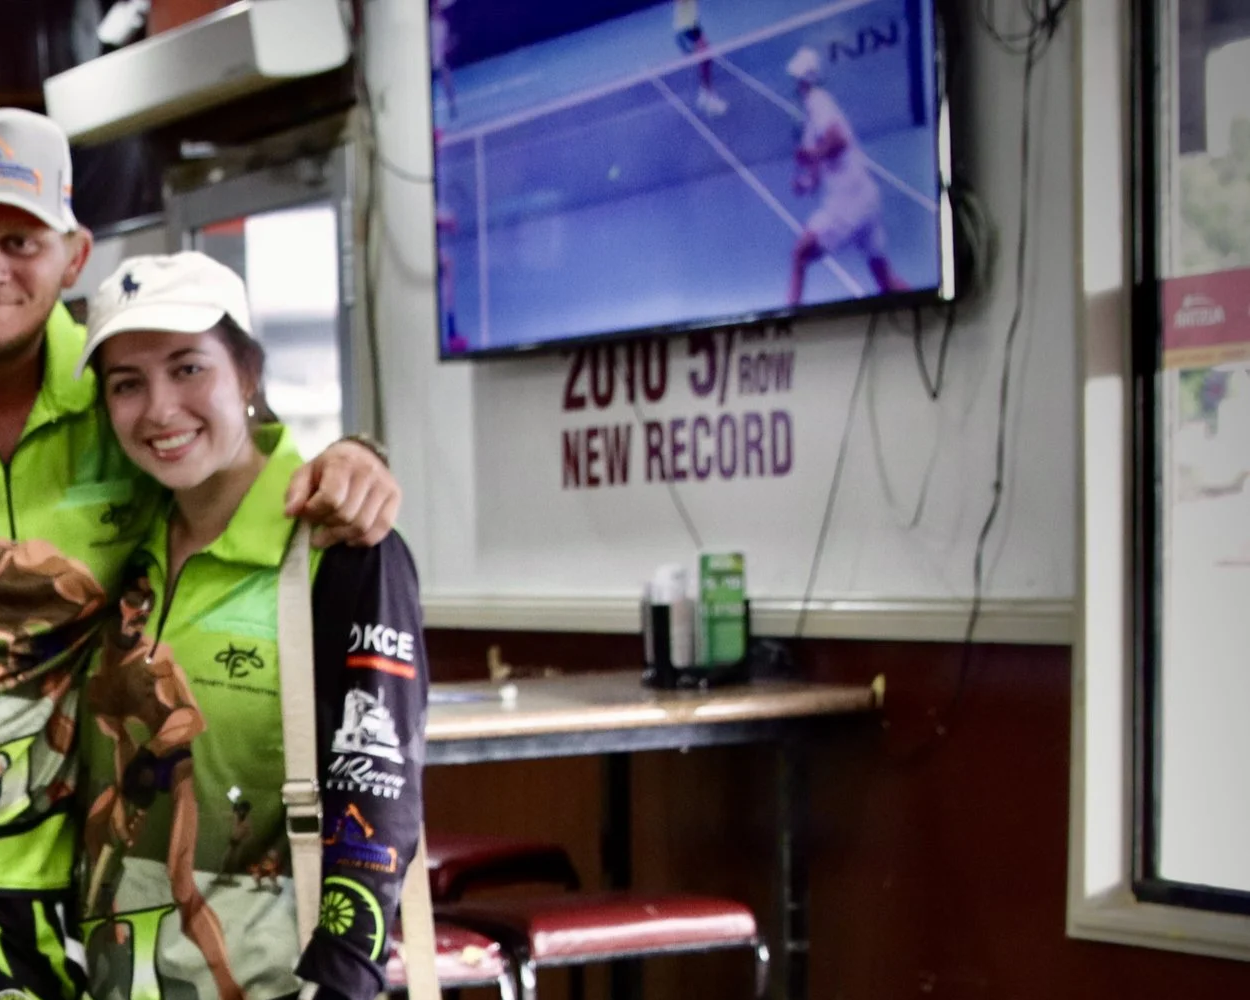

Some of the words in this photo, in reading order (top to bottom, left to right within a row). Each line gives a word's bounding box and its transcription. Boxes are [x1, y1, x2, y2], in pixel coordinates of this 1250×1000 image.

[739, 350, 795, 393] ROW
[561, 423, 632, 490] NEW
[645, 409, 793, 483] RECORD
